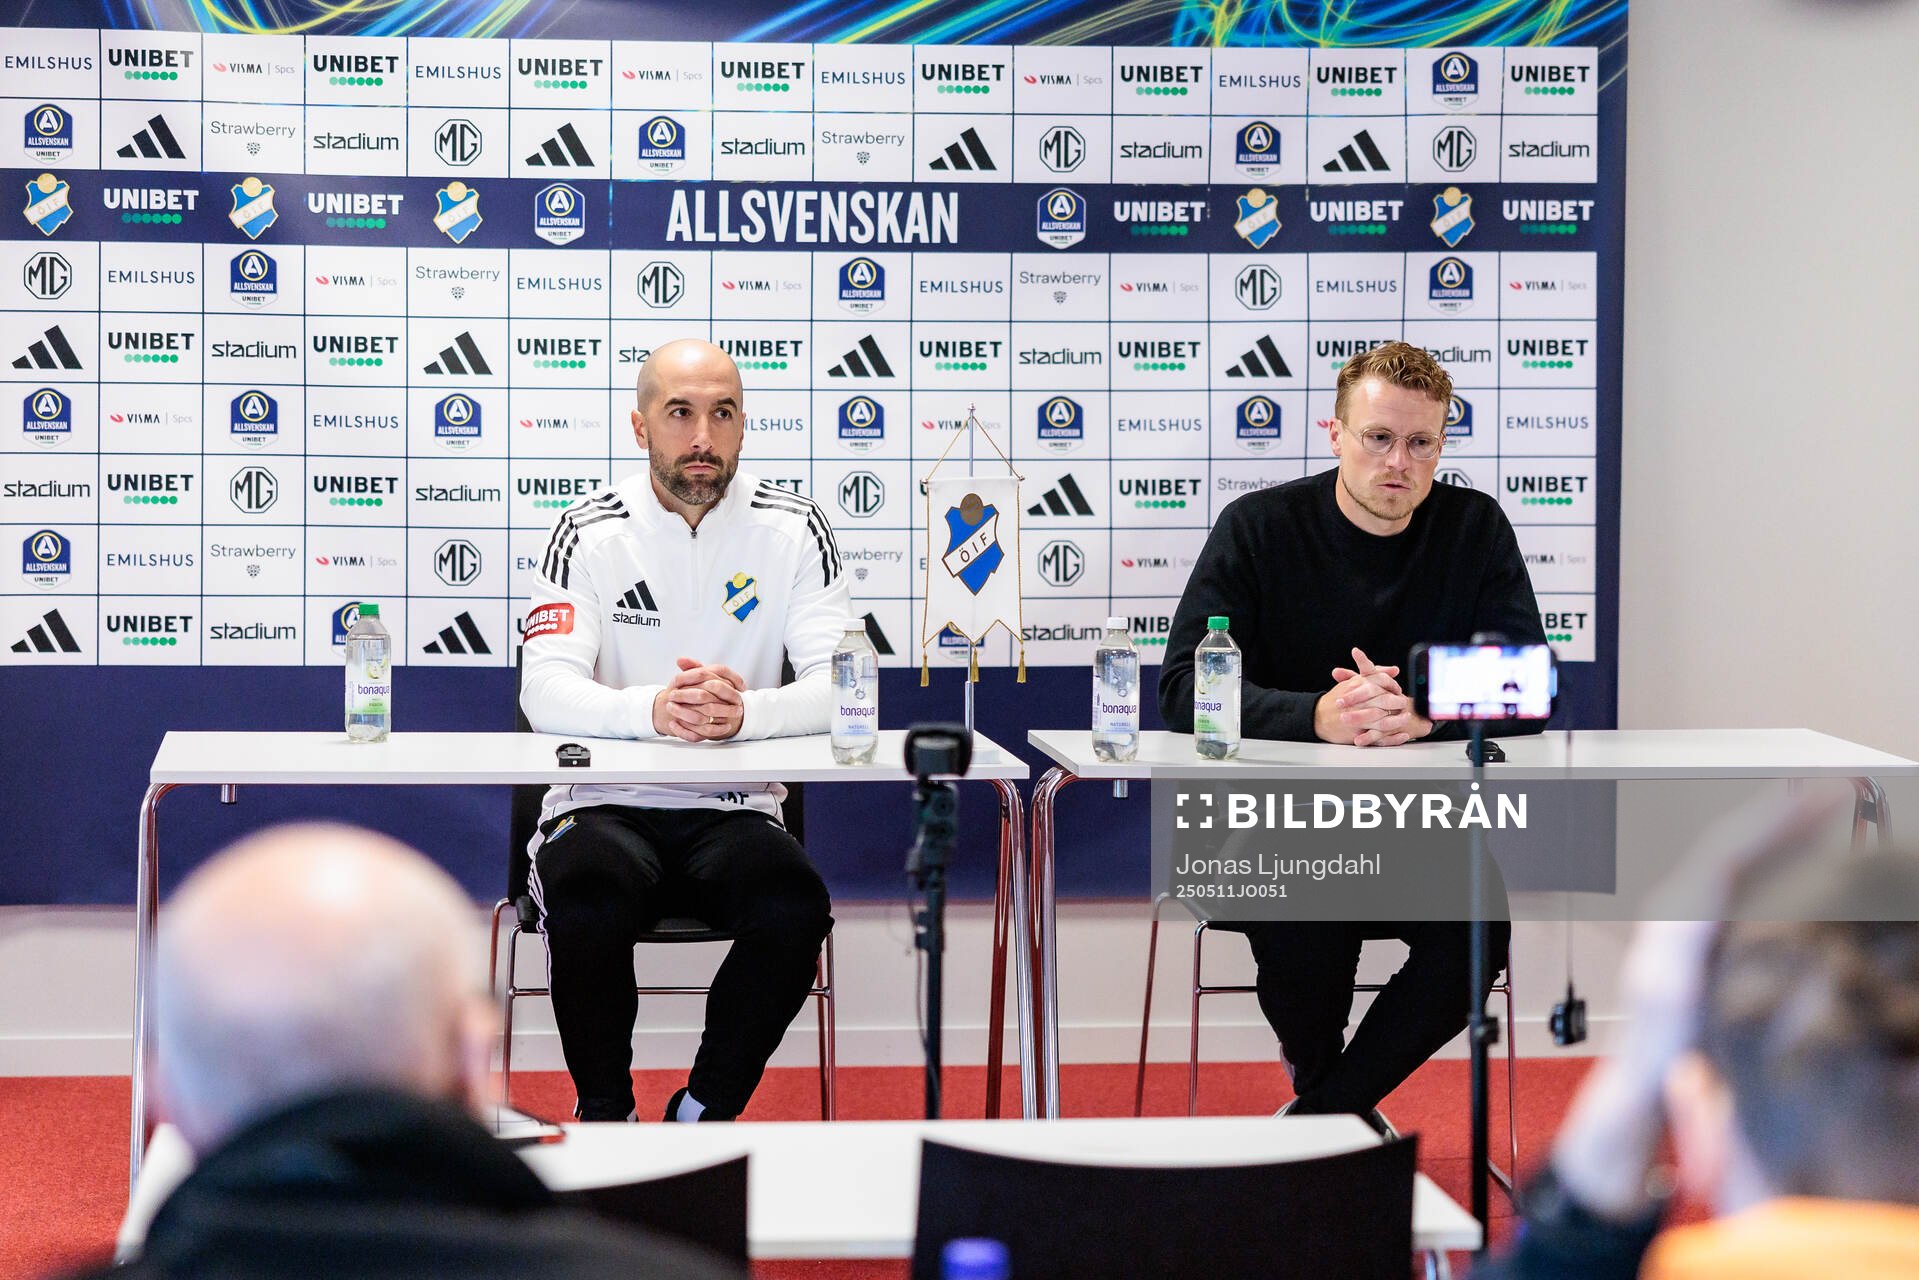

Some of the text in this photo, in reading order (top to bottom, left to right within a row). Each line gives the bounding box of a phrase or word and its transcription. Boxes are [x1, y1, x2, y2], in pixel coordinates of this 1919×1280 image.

[5, 56, 92, 70] EMILSHUS
[109, 49, 192, 67] UNIBET
[314, 55, 398, 73] UNIBET
[416, 66, 501, 79] EMILSHUS
[519, 58, 603, 76] UNIBET
[720, 61, 804, 80] UNIBET
[922, 64, 1005, 81] UNIBET
[1121, 66, 1203, 82] UNIBET
[1317, 67, 1397, 83] UNIBET
[1511, 66, 1590, 82] UNIBET
[822, 72, 905, 84] EMILSHUS
[1219, 75, 1300, 88] EMILSHUS
[211, 121, 295, 138] Strawberry
[27, 137, 69, 146] ALLSVENSKAN
[314, 133, 398, 150] stadium
[721, 138, 805, 155] stadium
[822, 131, 904, 146] Strawberry
[641, 149, 682, 158] ALLSVENSKAN
[1120, 142, 1202, 158] stadium
[1509, 141, 1589, 157] stadium
[104, 188, 199, 210] UNIBET
[308, 193, 403, 214] UNIBET
[666, 189, 958, 244] ALLSVENSKAN
[1113, 201, 1206, 222] UNIBET
[1310, 201, 1403, 222] UNIBET
[1503, 200, 1594, 220] UNIBET
[540, 217, 580, 226] ALLSVENSKAN
[109, 271, 194, 284] EMILSHUS
[416, 266, 499, 281] Strawberry
[1020, 271, 1101, 286] Strawberry
[233, 282, 274, 291] ALLSVENSKAN
[517, 278, 602, 290] EMILSHUS
[920, 281, 1003, 293] EMILSHUS
[1317, 280, 1397, 293] EMILSHUS
[108, 332, 194, 350] UNIBET
[313, 336, 398, 353] UNIBET
[518, 339, 601, 355] UNIBET
[720, 340, 803, 357] UNIBET
[920, 341, 1002, 357] UNIBET
[1508, 340, 1588, 355] UNIBET
[212, 341, 296, 358] stadium
[1019, 348, 1101, 364] stadium
[1119, 342, 1200, 358] UNIBET
[26, 421, 68, 430] ALLSVENSKAN
[233, 423, 275, 432] ALLSVENSKAN
[314, 415, 398, 428] EMILSHUS
[1118, 419, 1202, 431] EMILSHUS
[1507, 417, 1588, 429] EMILSHUS
[437, 426, 479, 435] ALLSVENSKAN
[4, 480, 90, 497] stadium
[108, 474, 193, 491] UNIBET
[314, 476, 398, 493] UNIBET
[517, 478, 602, 496] UNIBET
[1120, 479, 1201, 495] UNIBET
[1507, 477, 1587, 492] UNIBET
[416, 485, 500, 501] stadium
[211, 544, 296, 559] Strawberry
[958, 532, 988, 563] ÖIF
[26, 562, 67, 571] ALLSVENSKAN
[107, 554, 193, 566] EMILSHUS
[107, 616, 192, 632] UNIBET
[612, 611, 661, 628] stadium
[210, 623, 296, 639] stadium
[1022, 625, 1101, 641] stadium
[358, 684, 389, 696] bonaqua
[840, 705, 876, 718] bonaqua
[1102, 703, 1137, 716] bonaqua
